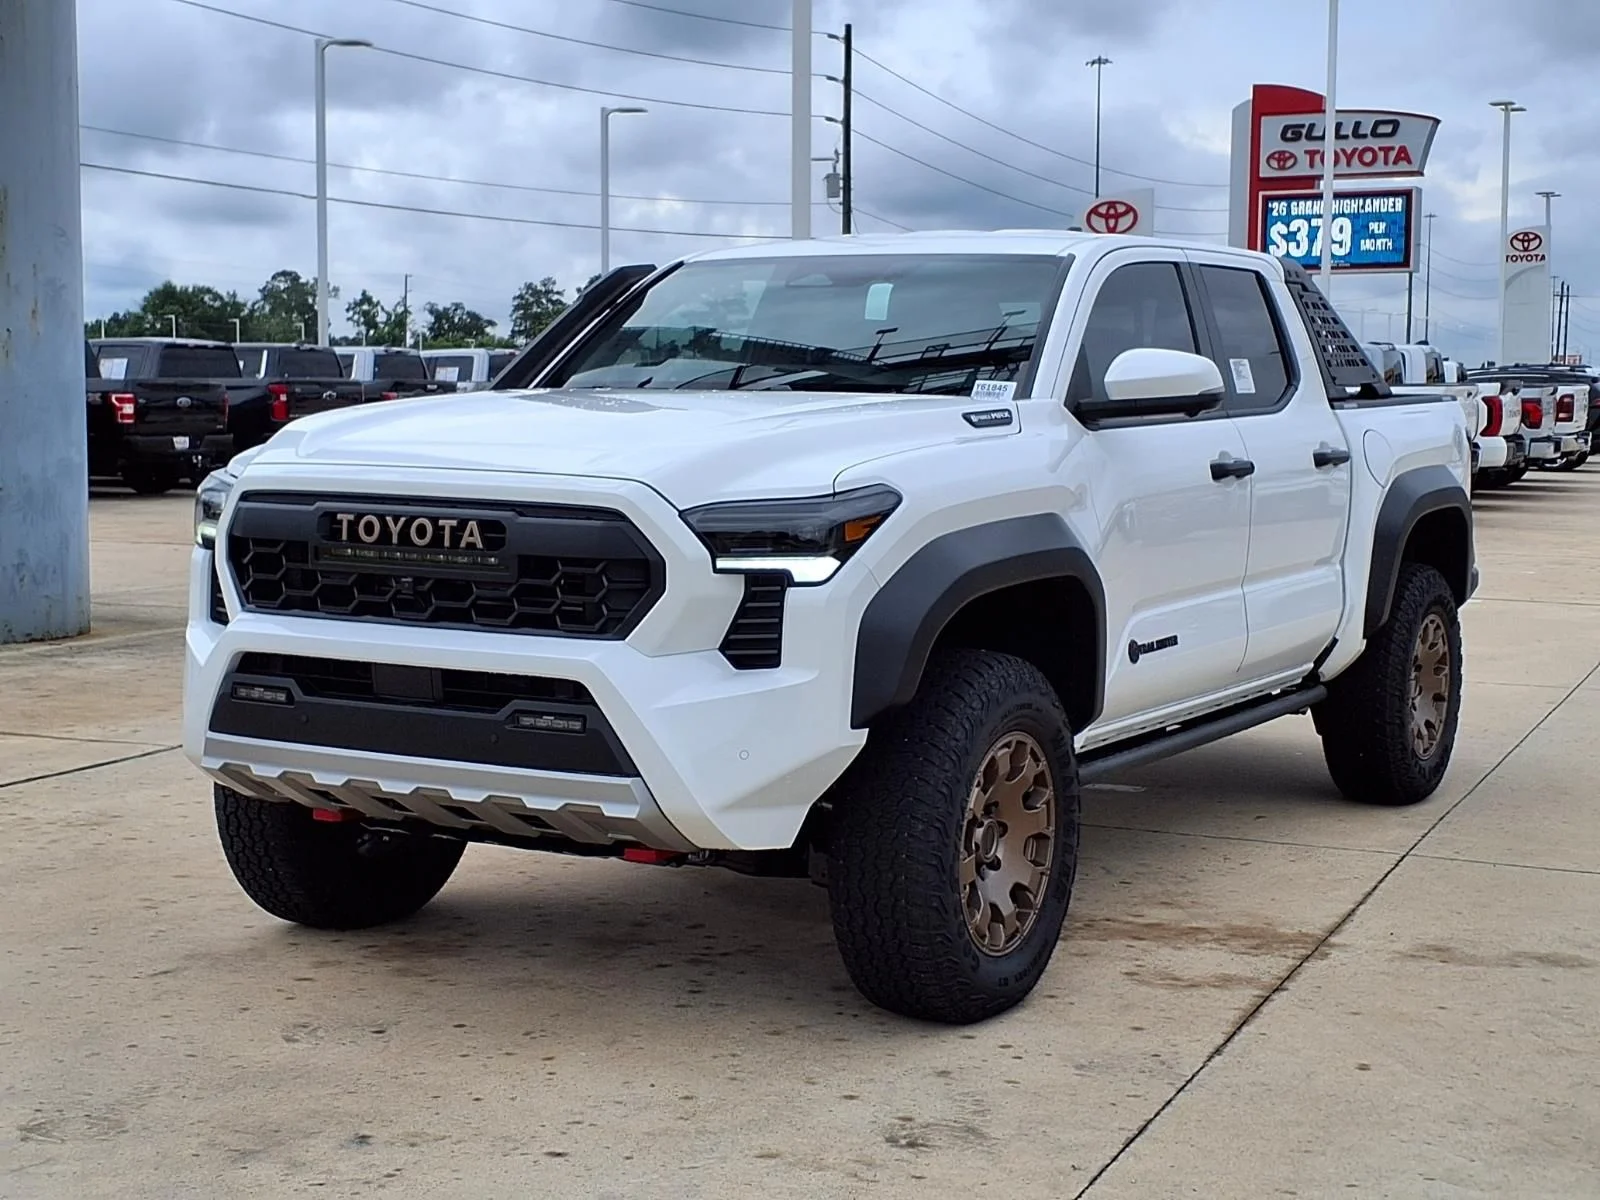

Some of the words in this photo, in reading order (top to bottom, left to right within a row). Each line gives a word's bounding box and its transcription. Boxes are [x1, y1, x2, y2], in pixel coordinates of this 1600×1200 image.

[1280, 118, 1400, 142] GULLO
[1304, 145, 1412, 169] TOYOTA
[1331, 197, 1402, 213] HIGHLANDER
[1268, 217, 1351, 257] $379
[1368, 221, 1387, 234] PER
[1360, 238, 1392, 251] MONTH
[1505, 253, 1546, 263] TOYOTA
[336, 513, 484, 550] TOYOTA
